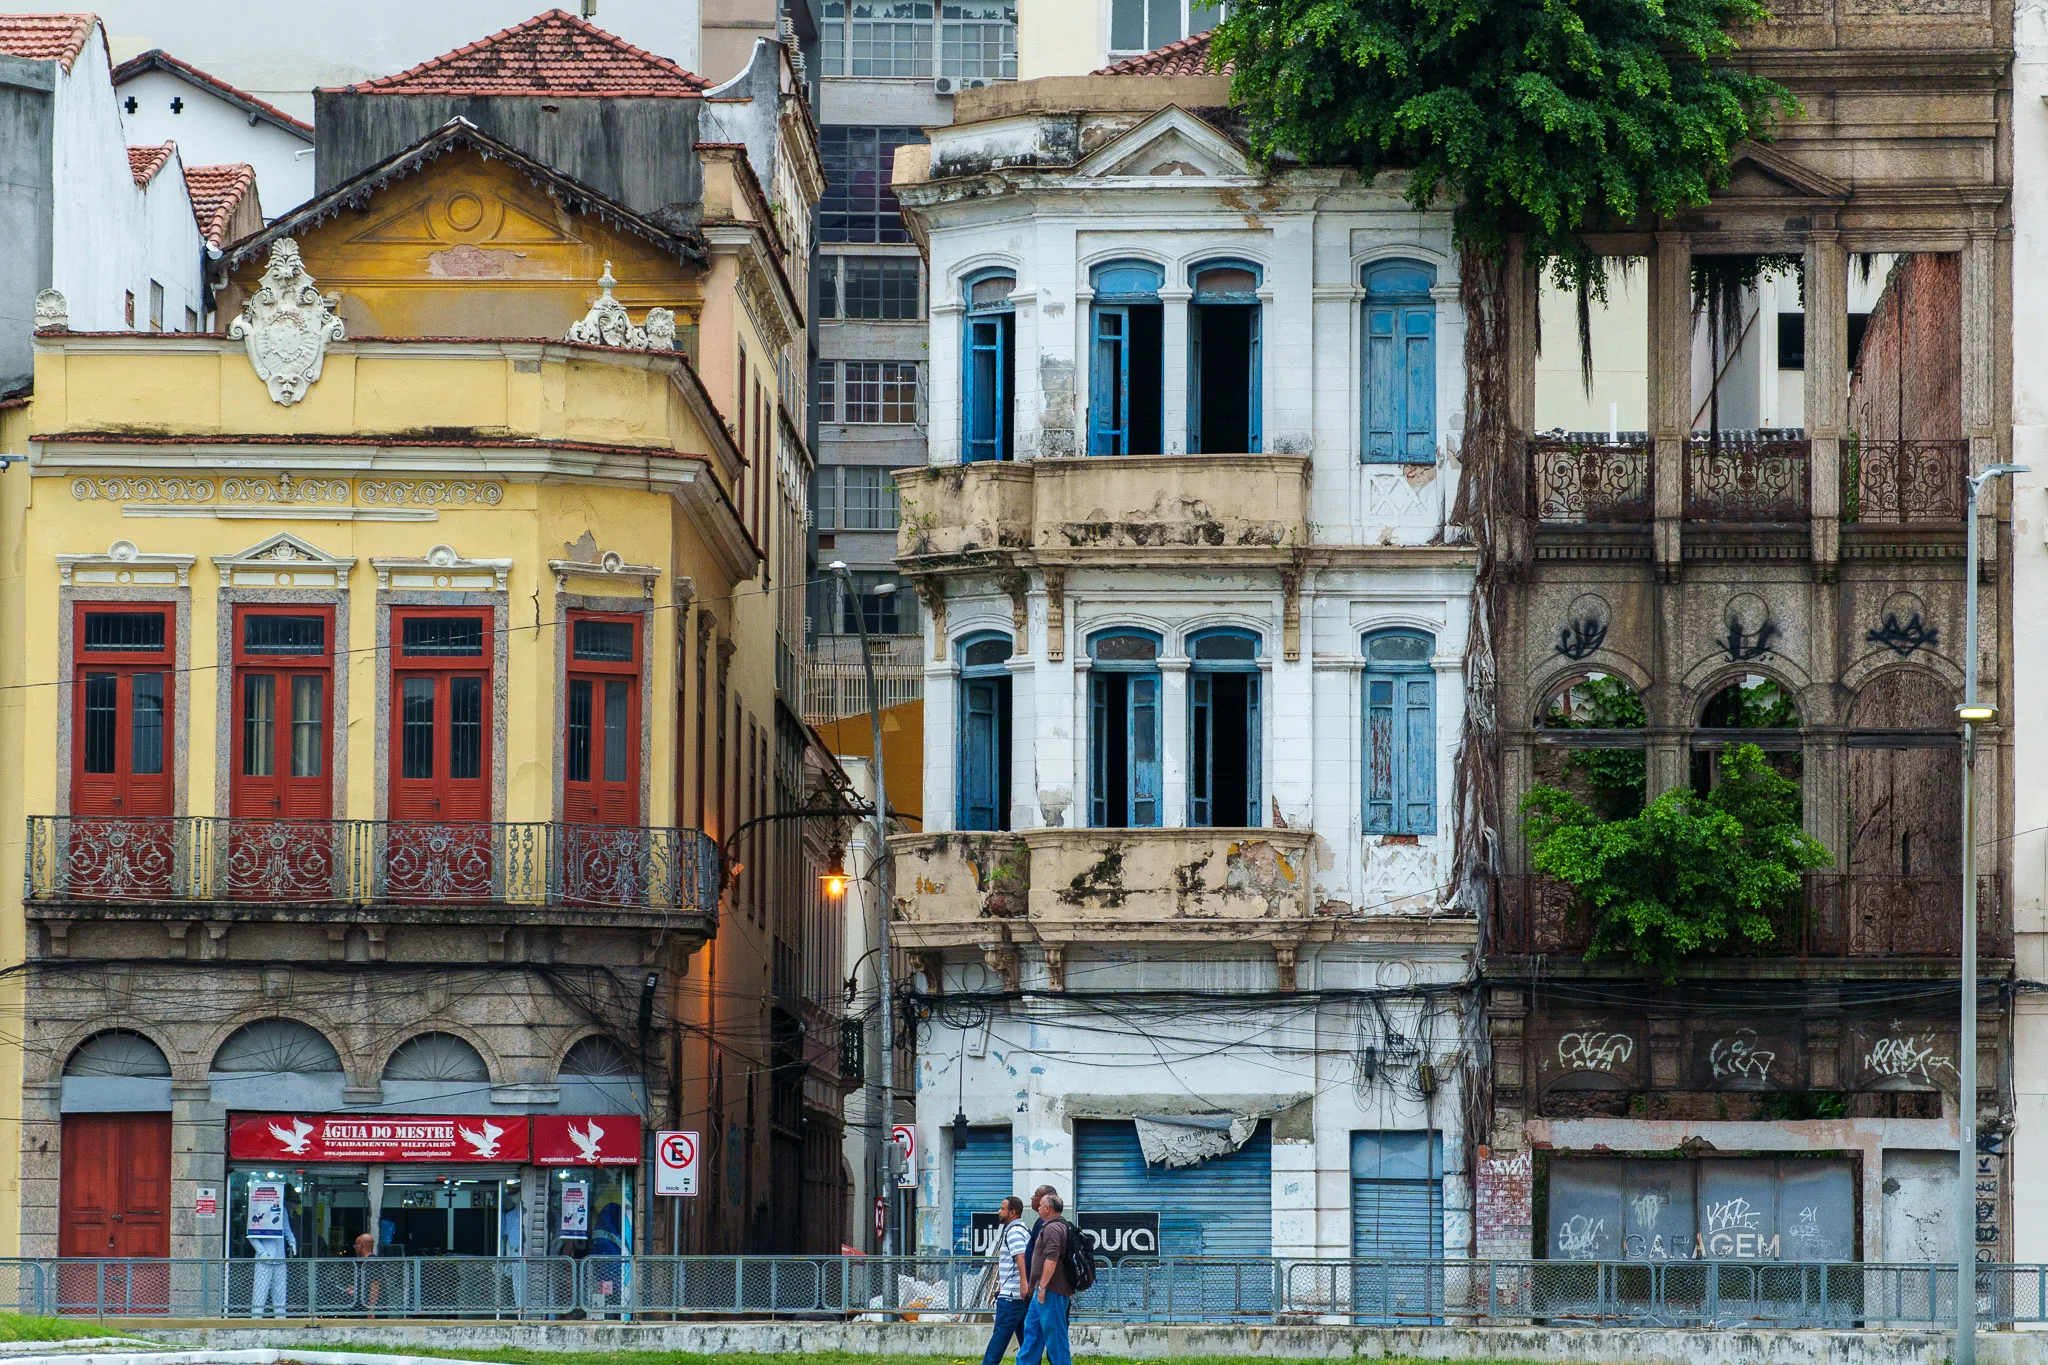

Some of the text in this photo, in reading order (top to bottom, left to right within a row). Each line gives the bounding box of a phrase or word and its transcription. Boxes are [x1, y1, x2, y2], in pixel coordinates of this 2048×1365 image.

[321, 1123, 454, 1139] ÁGUIA DO MESTRE
[1623, 1233, 1780, 1259] GARAGEM
